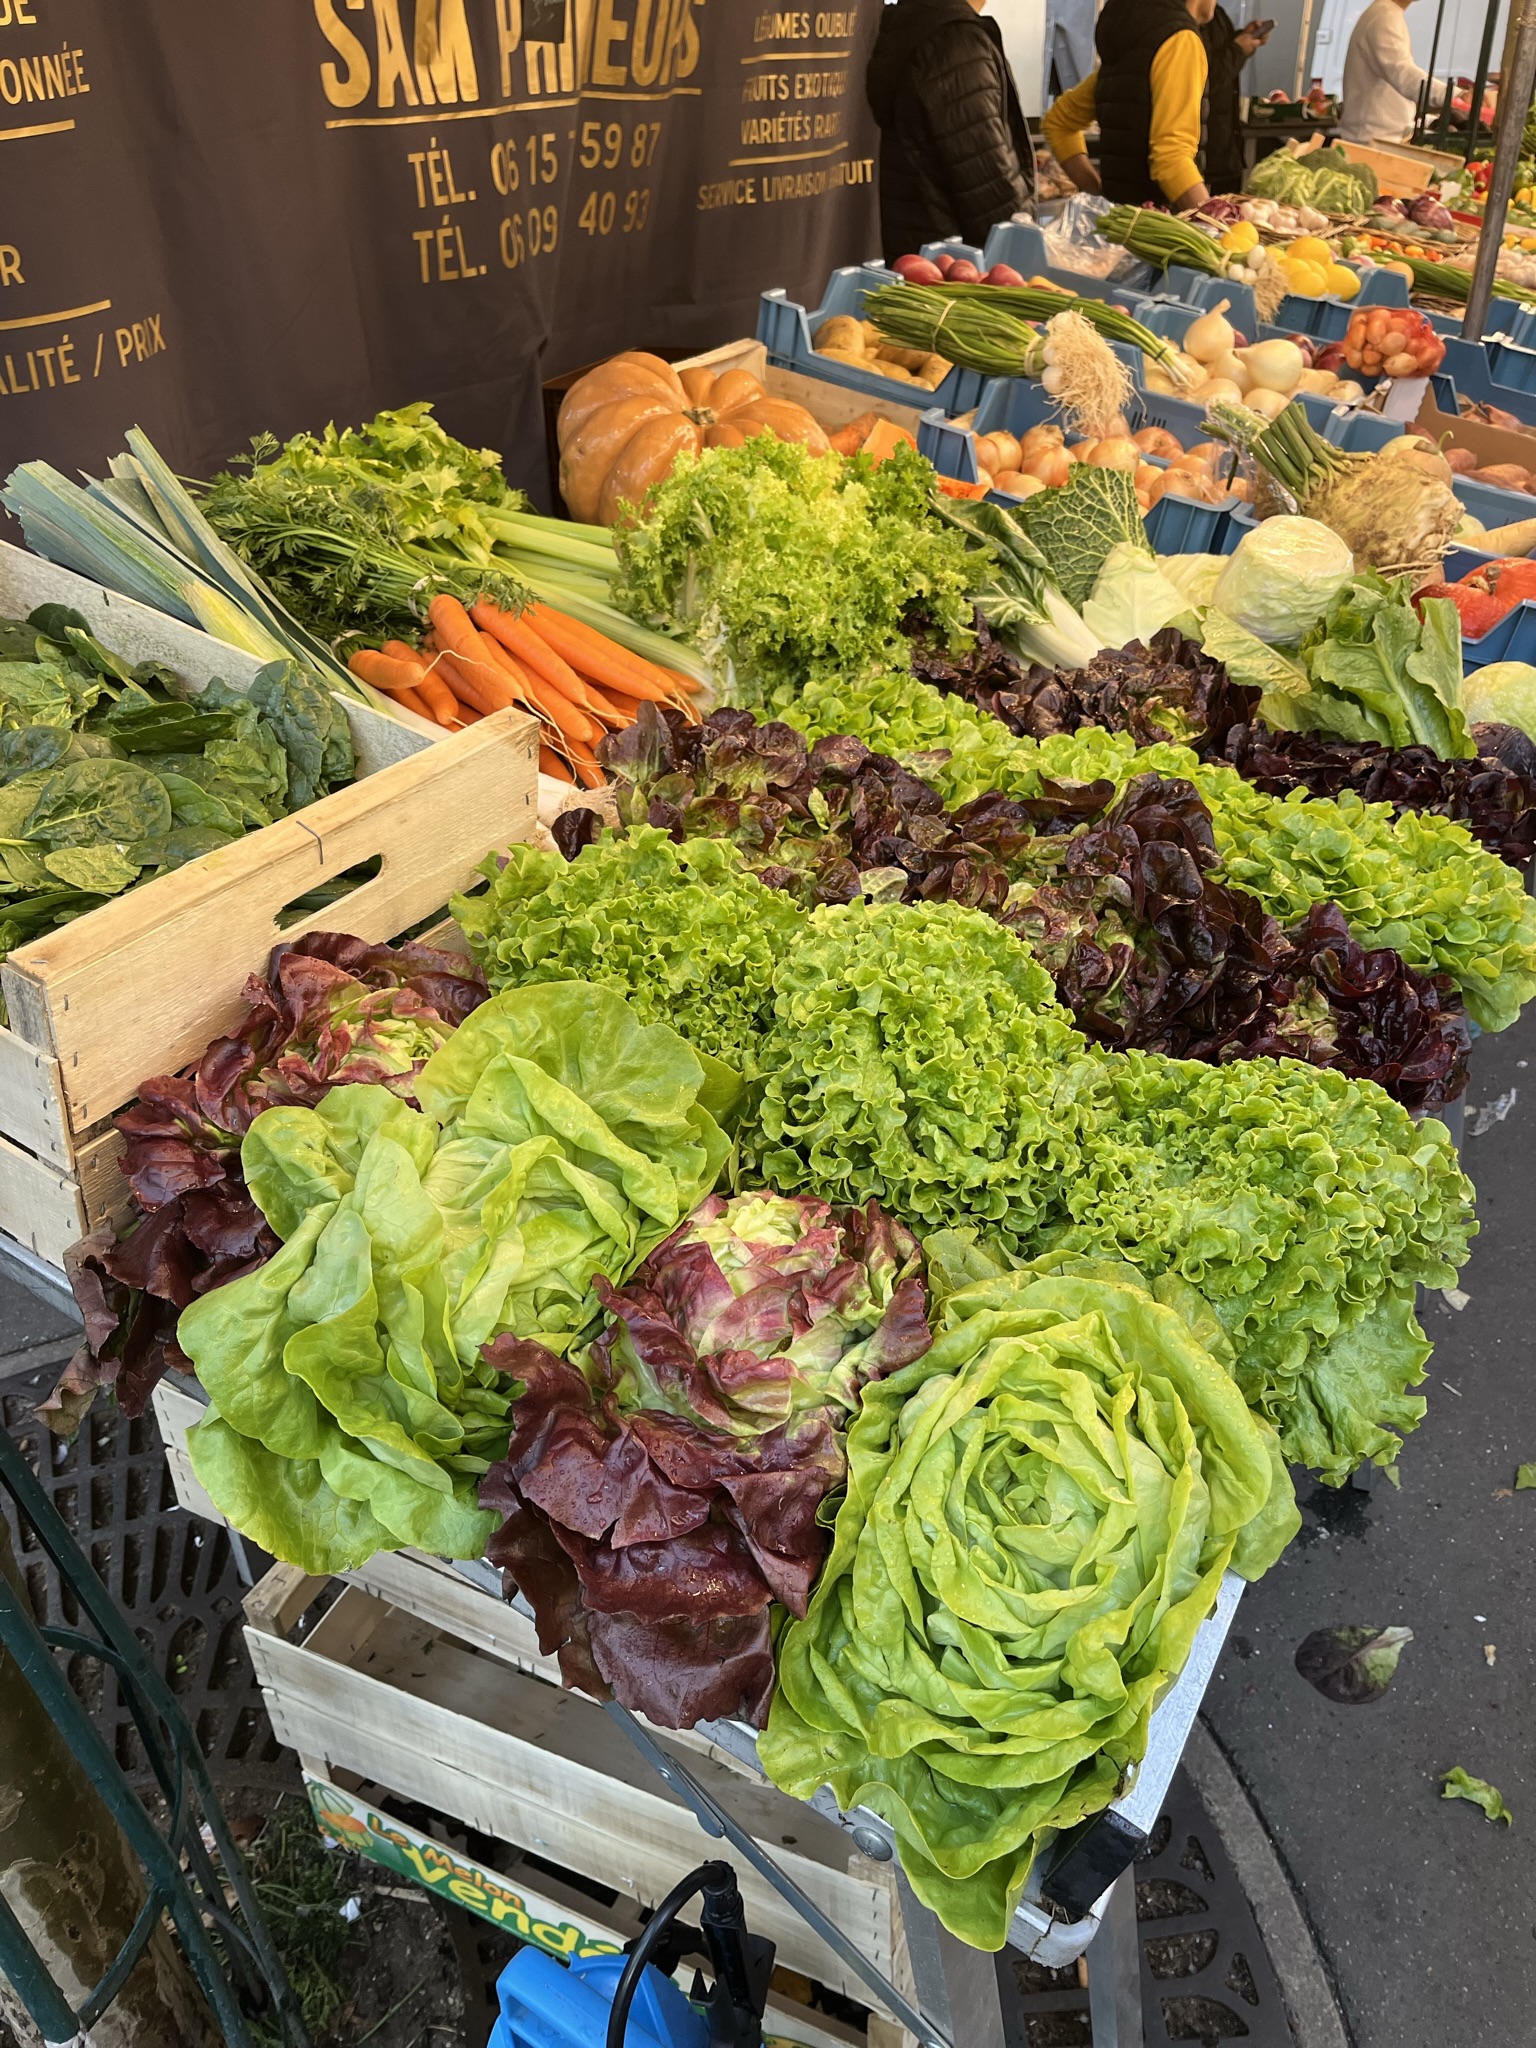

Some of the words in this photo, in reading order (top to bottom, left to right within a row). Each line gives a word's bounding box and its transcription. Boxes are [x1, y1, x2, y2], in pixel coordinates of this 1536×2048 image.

[314, 0, 480, 108] SAM
[407, 137, 477, 208] TÉL.
[490, 138, 520, 195] 06
[526, 133, 559, 185] 15
[579, 121, 623, 169] 59
[630, 121, 662, 168] 87
[741, 110, 811, 145] VARIÉTÉS
[412, 214, 487, 284] TÉL.
[528, 204, 558, 256] 09
[578, 191, 616, 236] 40
[115, 313, 167, 368] PRIX
[369, 1814, 410, 1848] Le
[423, 1846, 523, 1911] Melon
